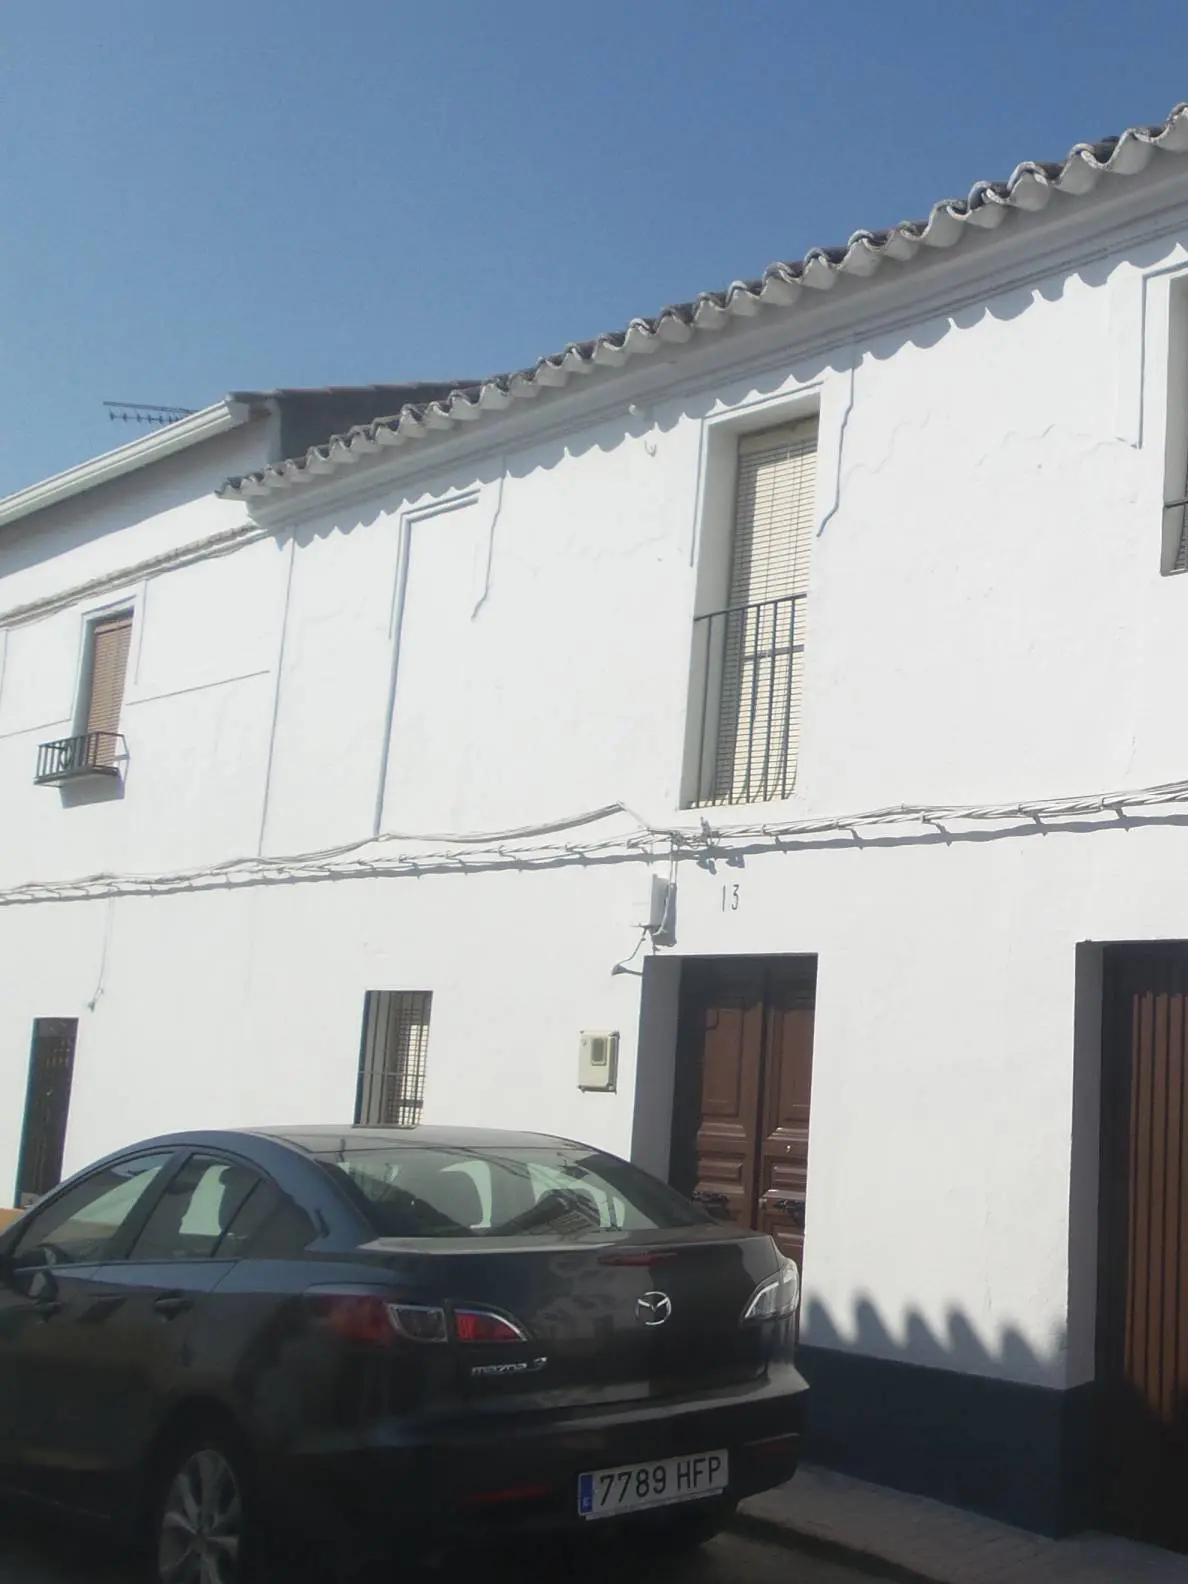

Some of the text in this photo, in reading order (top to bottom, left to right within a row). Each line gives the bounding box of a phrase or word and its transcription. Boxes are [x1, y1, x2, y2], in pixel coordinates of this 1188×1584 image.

[722, 884, 739, 912] 13
[600, 1456, 721, 1506] 7789 HFP
